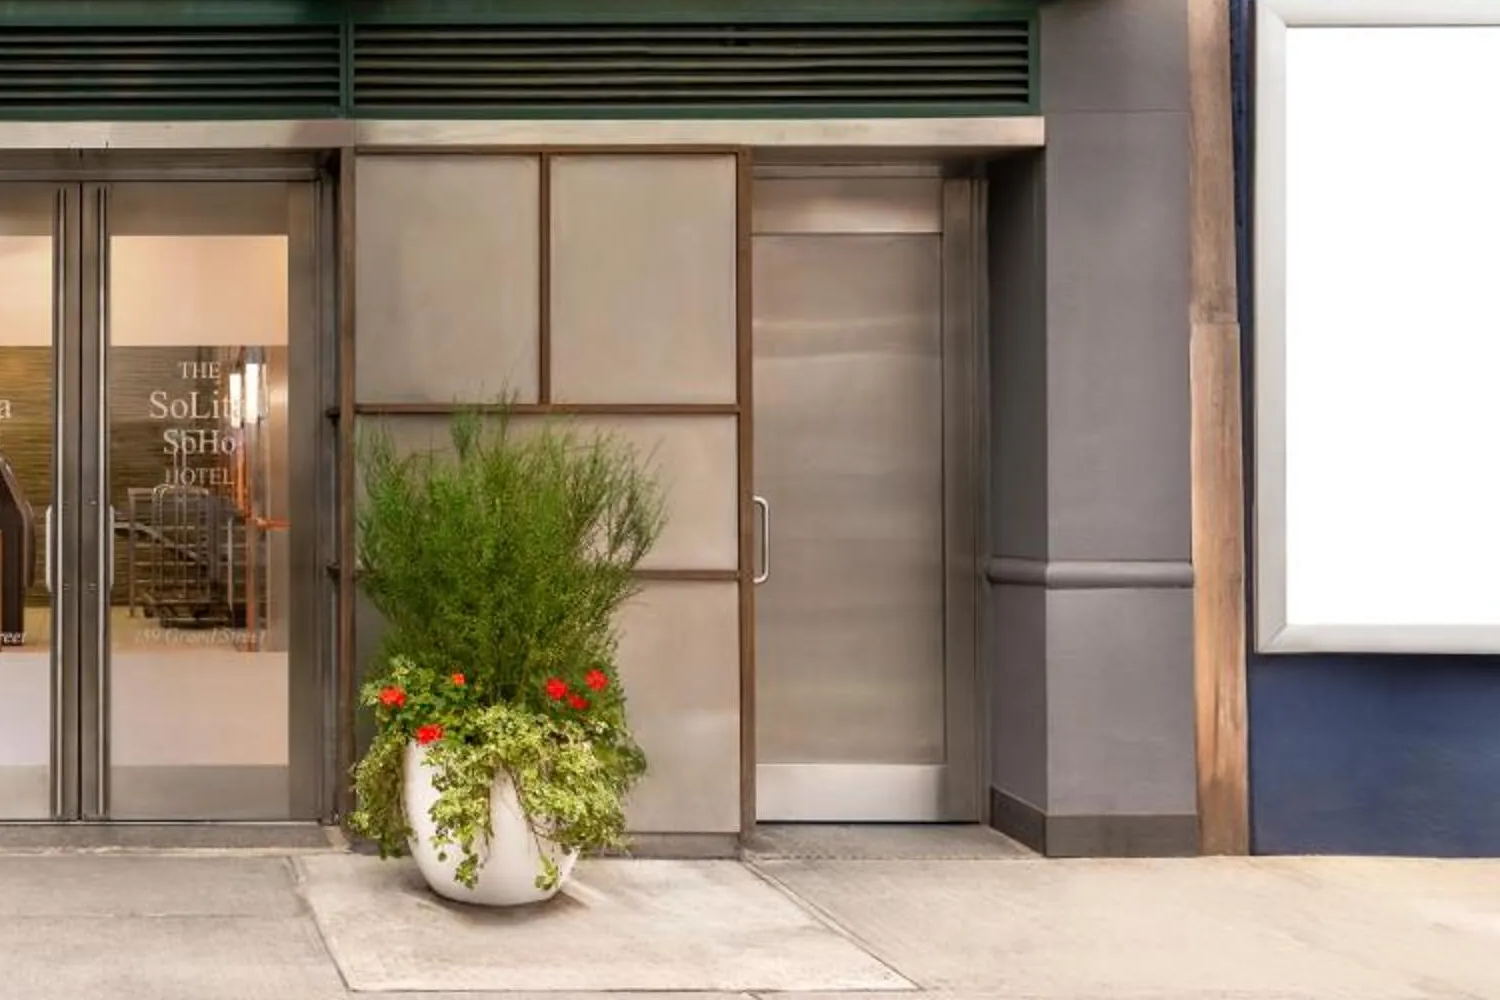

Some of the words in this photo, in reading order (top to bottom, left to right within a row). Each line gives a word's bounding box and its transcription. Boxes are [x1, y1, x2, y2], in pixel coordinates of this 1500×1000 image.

[178, 361, 221, 379] THE
[163, 428, 237, 454] SoHo
[165, 467, 235, 485] HOTEL
